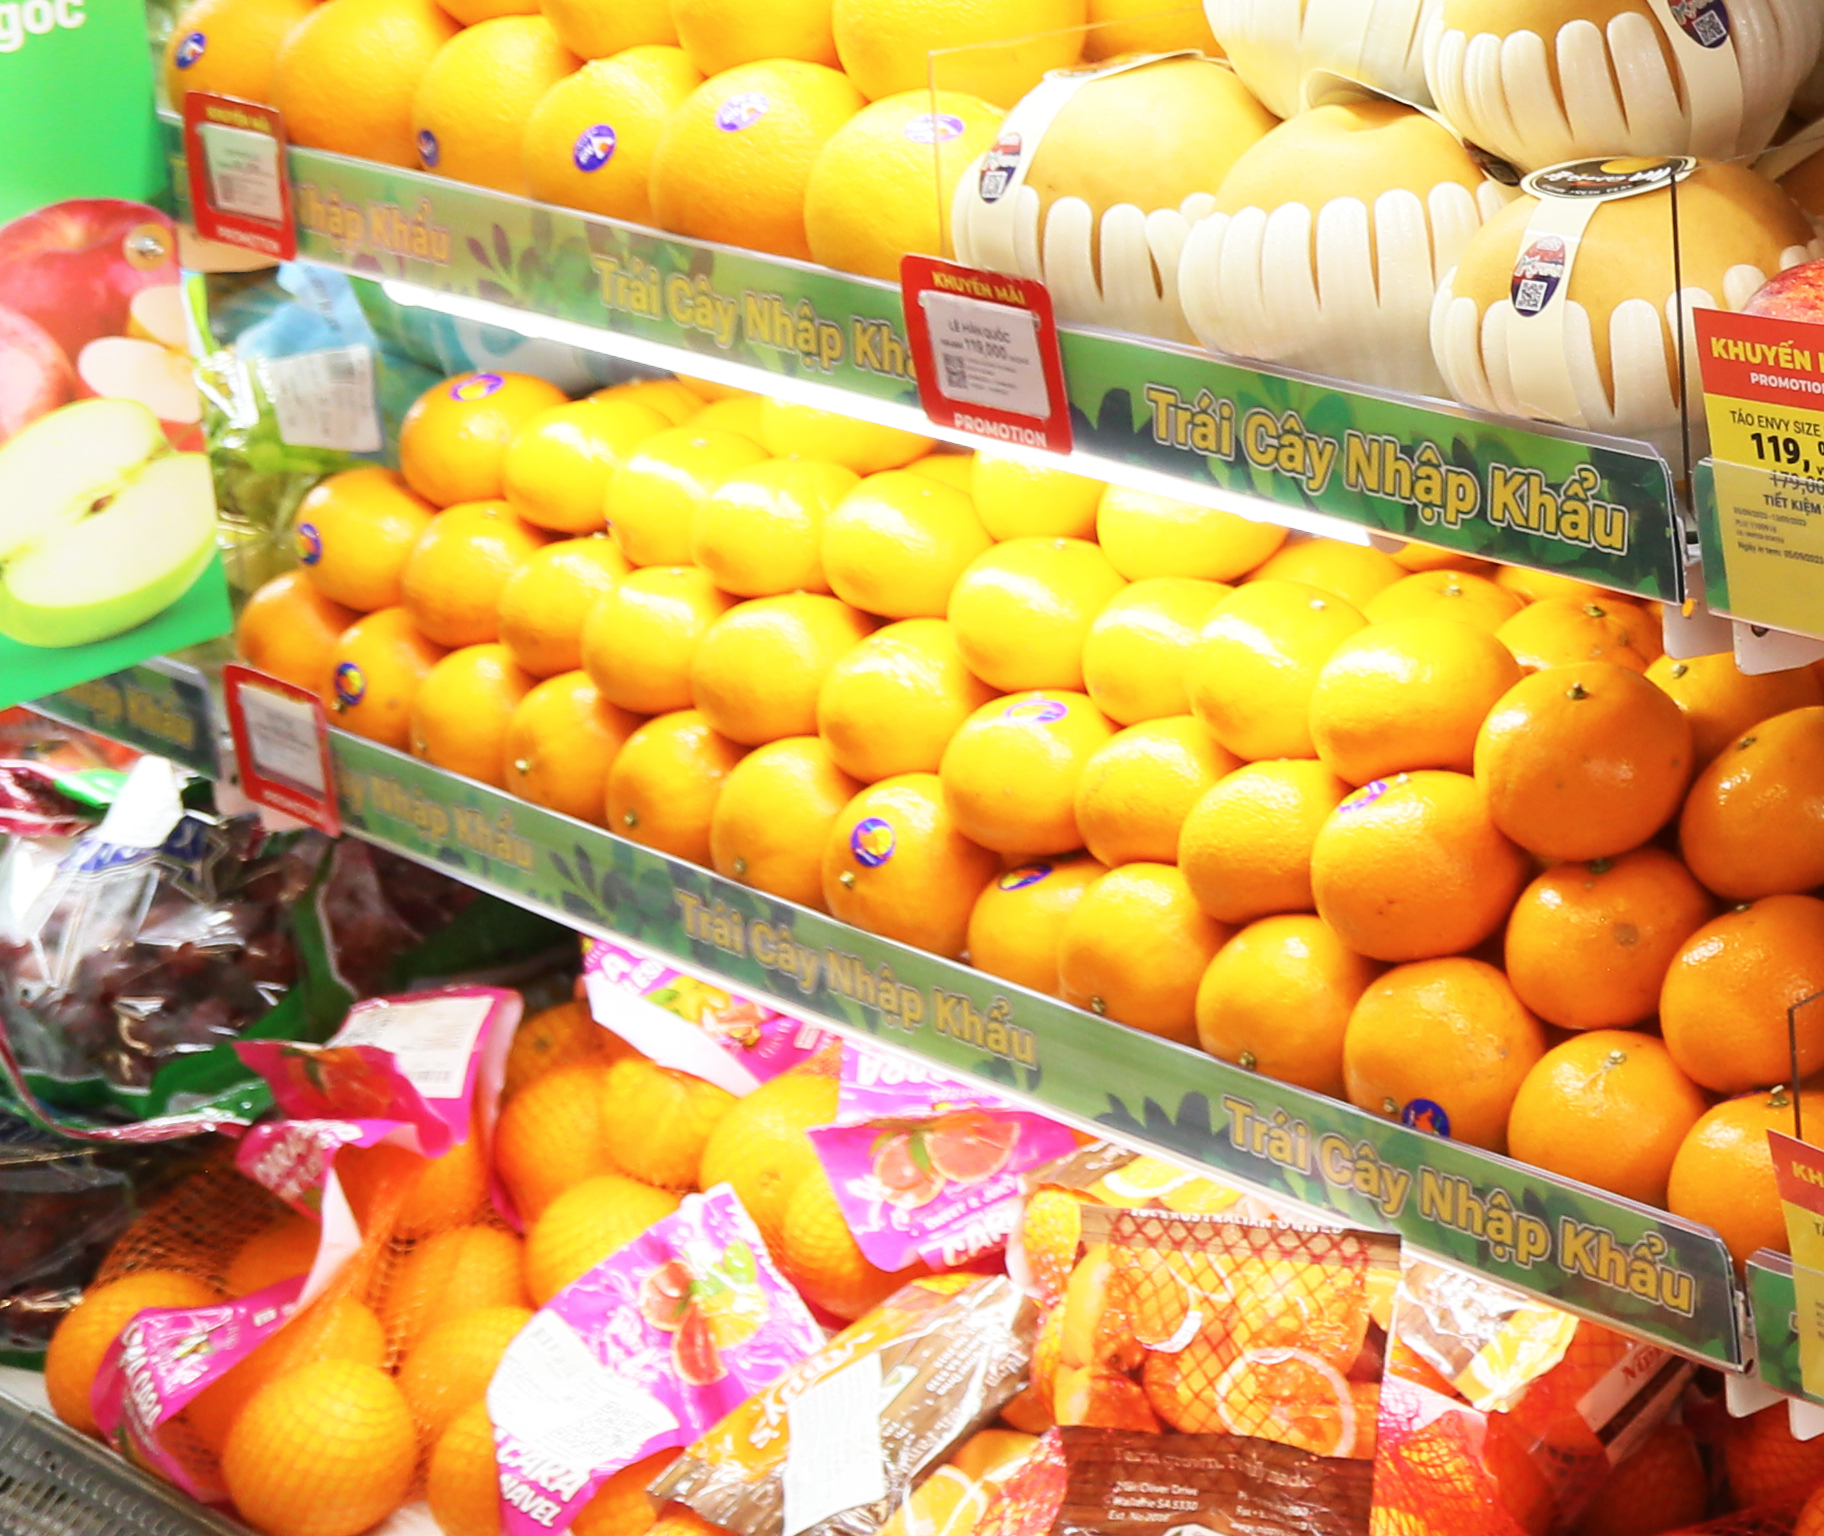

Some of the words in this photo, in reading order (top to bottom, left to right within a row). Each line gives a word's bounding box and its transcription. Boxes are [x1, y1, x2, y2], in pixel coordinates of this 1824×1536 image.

[931, 271, 993, 299] KHUYẾN
[993, 283, 1026, 305] MÃI
[592, 254, 663, 321] Trái
[666, 272, 738, 349] Cây
[743, 289, 845, 374] Nhập
[965, 338, 1008, 360] 119,000
[1710, 337, 1811, 373] KHUYẾN
[953, 411, 1048, 448] PROMOTION
[1729, 407, 1755, 427] TÁO
[1757, 414, 1790, 432] ENVY
[1793, 420, 1821, 439] SIZE
[1145, 382, 1233, 460] Trái
[1242, 401, 1337, 495] Cây
[1343, 431, 1480, 530] Nhập
[1488, 463, 1628, 557] Khẩu
[1750, 432, 1811, 473] 119,
[1763, 492, 1790, 510] TIẾT
[1791, 496, 1823, 518] KIỆM
[675, 887, 744, 958] Trái
[750, 918, 818, 994] Cây
[824, 946, 924, 1033] Nhập
[931, 986, 1038, 1070] Khẩu
[1221, 1094, 1310, 1175] Trái
[1318, 1129, 1408, 1216] Cây
[1417, 1163, 1550, 1268] Nhập
[1560, 1216, 1696, 1319] Khẩu
[496, 1439, 591, 1503] CARA
[500, 1473, 563, 1529] NAVEL
